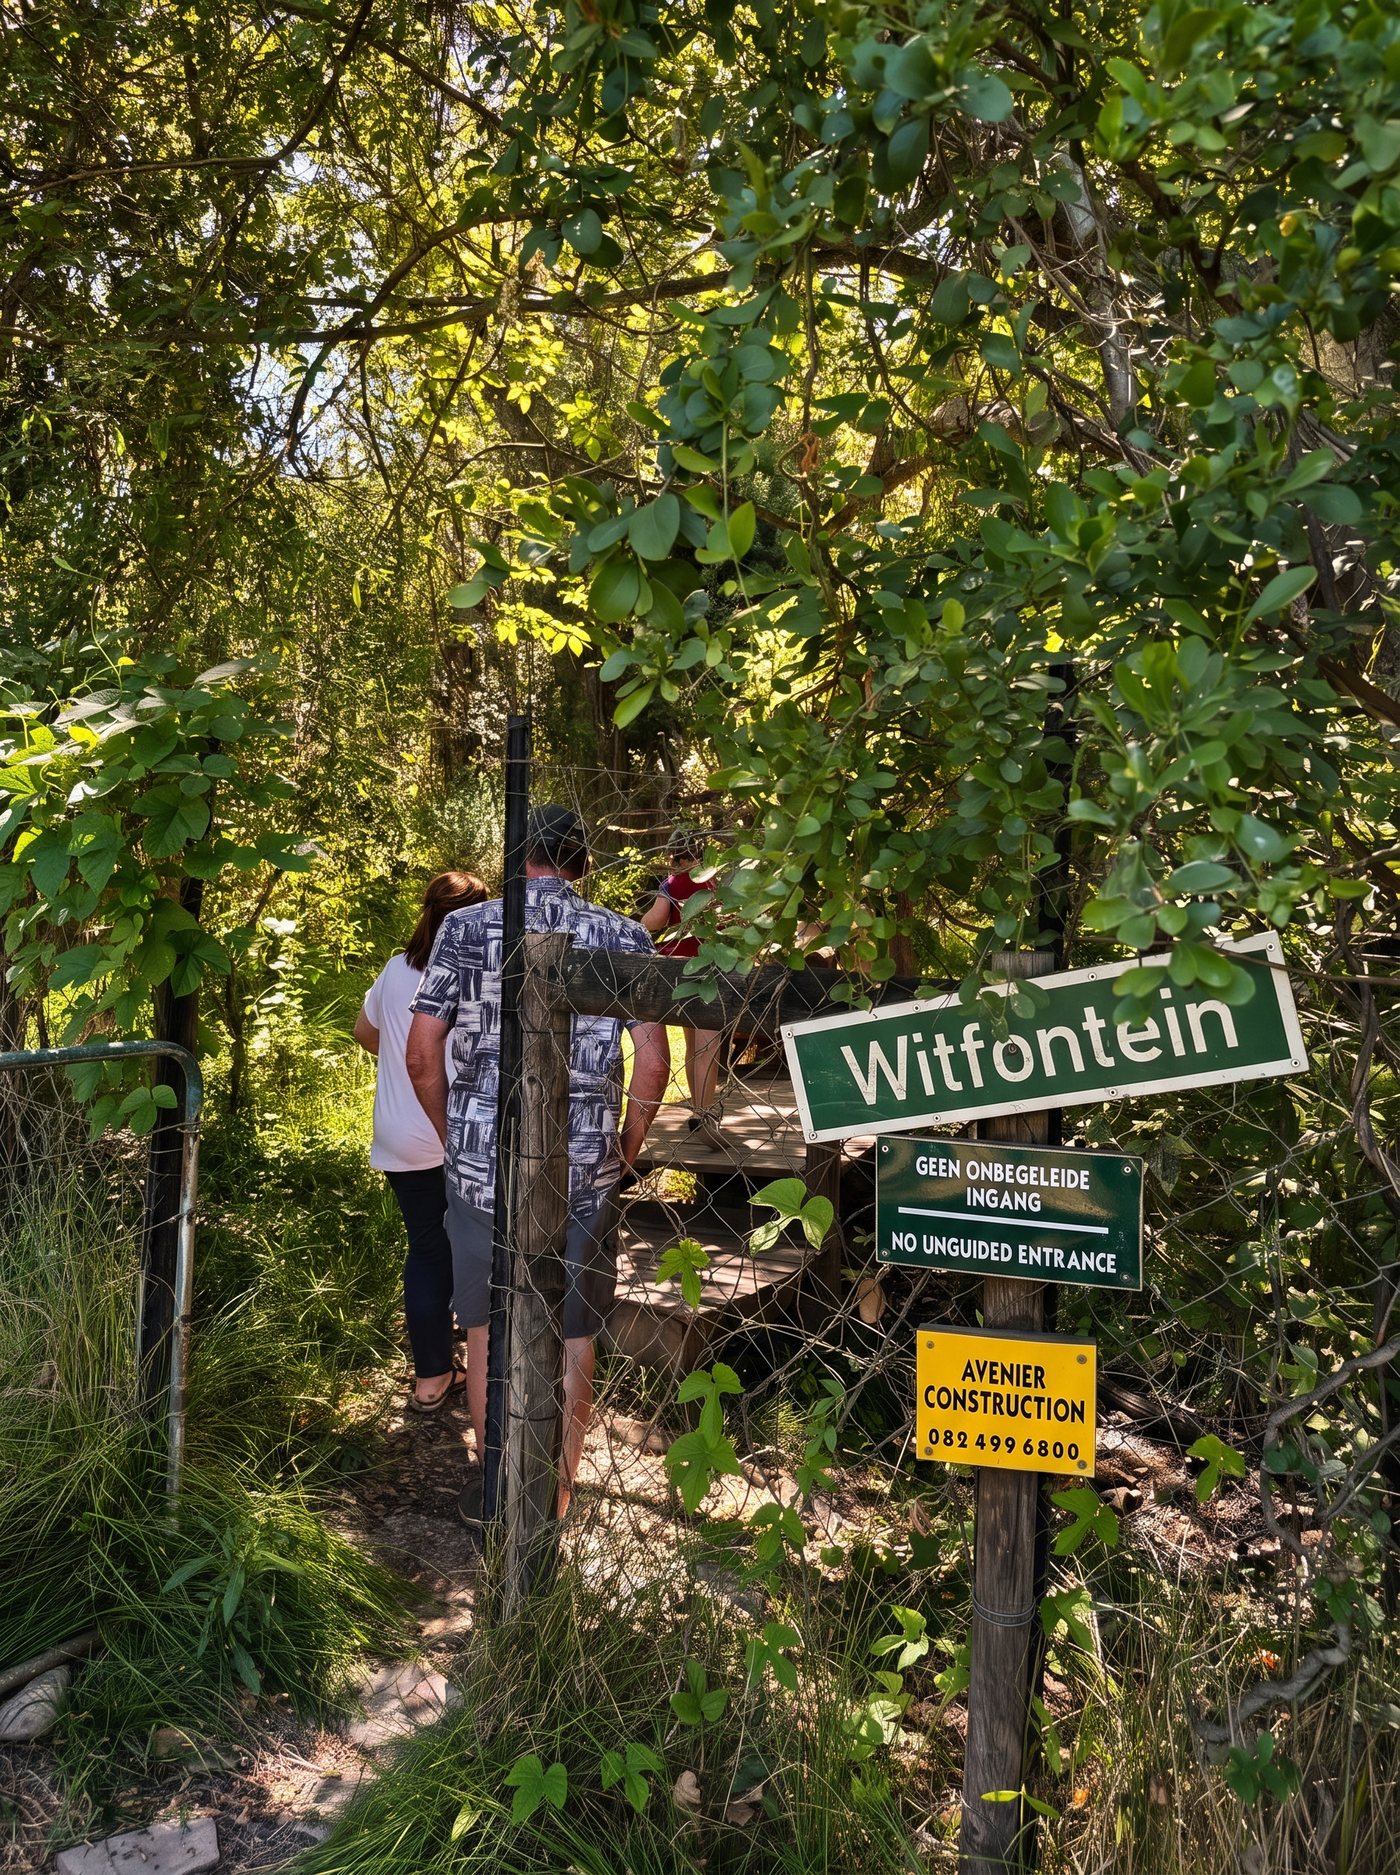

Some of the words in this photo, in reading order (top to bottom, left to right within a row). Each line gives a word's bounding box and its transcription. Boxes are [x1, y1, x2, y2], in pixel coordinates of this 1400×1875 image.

[839, 987, 1239, 1106] Witfontein
[915, 1155, 961, 1179] GEEN
[965, 1160, 1090, 1190] ONBEGELEIDE
[966, 1186, 1041, 1213] INGANG
[891, 1231, 917, 1253] NO
[922, 1234, 1013, 1262] UNGUIDED
[1018, 1244, 1117, 1274] ENTRANCE
[961, 1359, 1046, 1390] AVENIER
[924, 1385, 1085, 1425] CONSTRUCTION
[928, 1428, 968, 1449] 082
[974, 1433, 1016, 1454] 499
[1022, 1438, 1079, 1461] 6800
